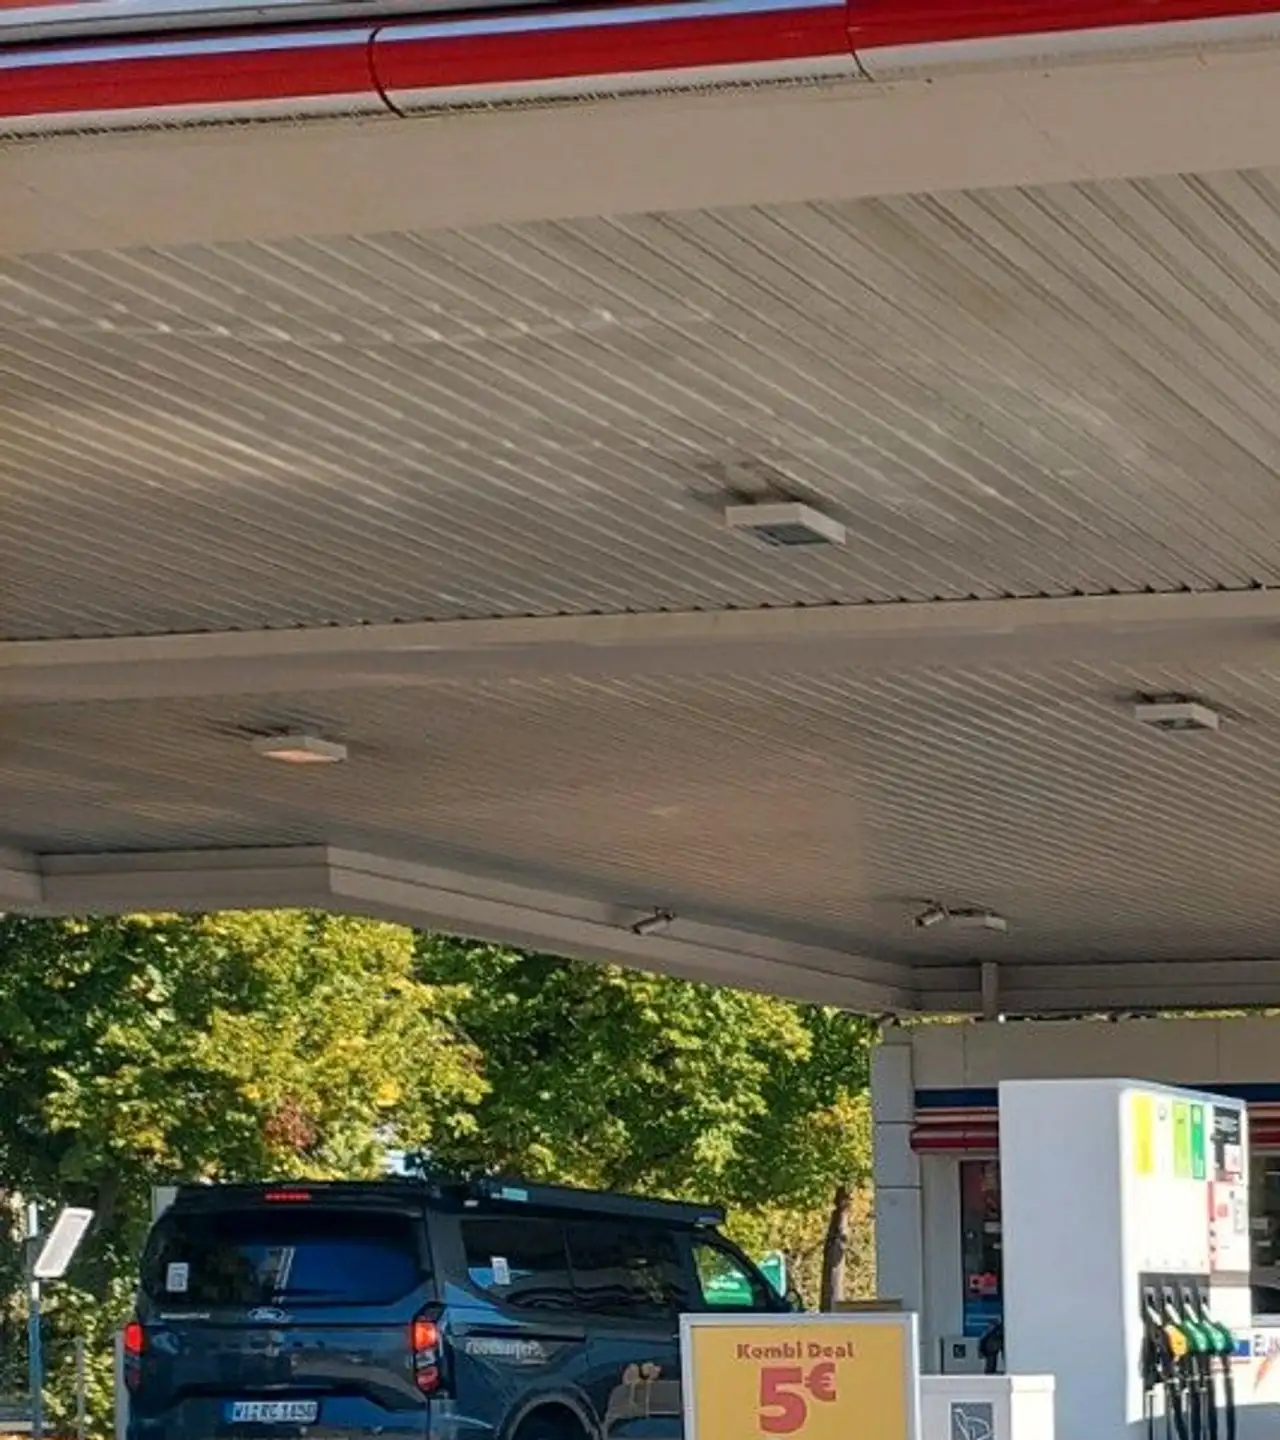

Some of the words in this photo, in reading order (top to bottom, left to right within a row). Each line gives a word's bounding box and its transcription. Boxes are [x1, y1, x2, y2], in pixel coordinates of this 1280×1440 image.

[736, 1341, 801, 1359] Kombi
[808, 1342, 854, 1358] Deal
[759, 1361, 837, 1434] 5€
